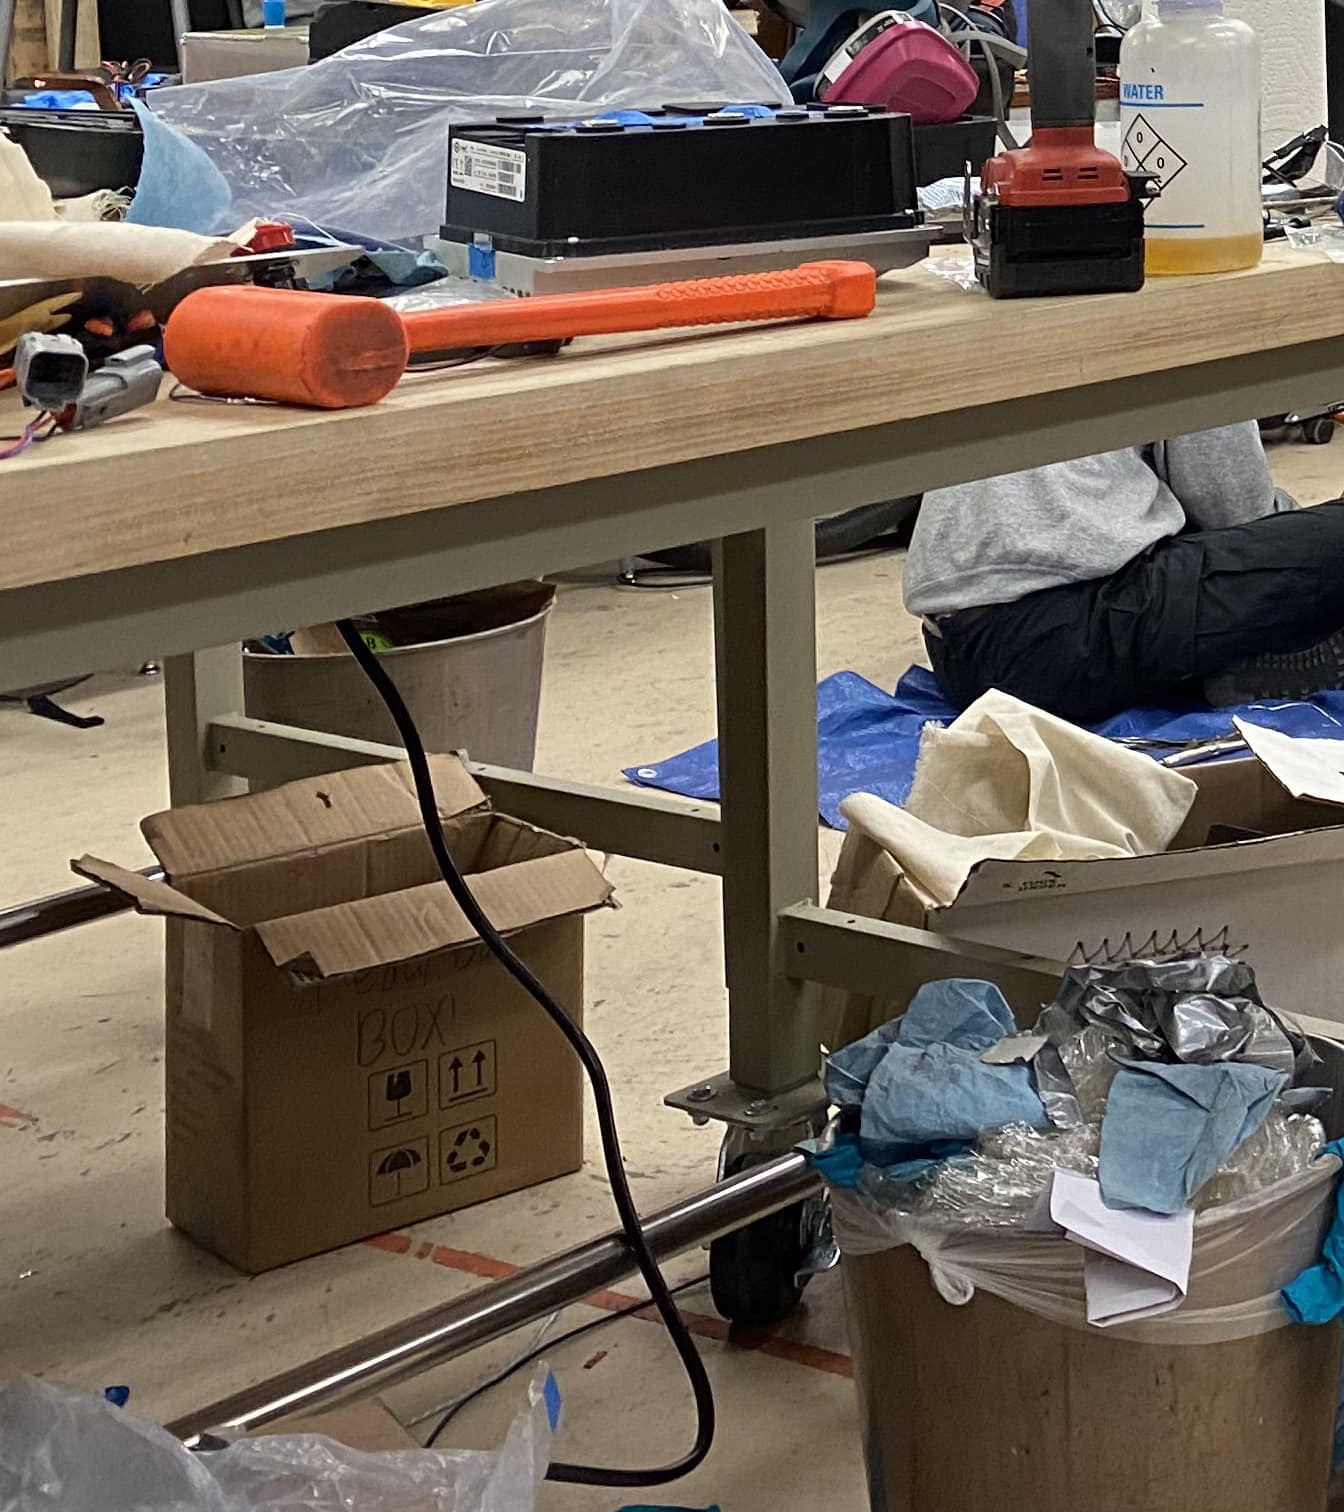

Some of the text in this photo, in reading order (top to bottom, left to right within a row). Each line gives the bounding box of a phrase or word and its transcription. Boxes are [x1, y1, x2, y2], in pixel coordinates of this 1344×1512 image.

[1123, 84, 1164, 100] WATER
[1136, 132, 1143, 143] 0
[1157, 157, 1164, 168] 0
